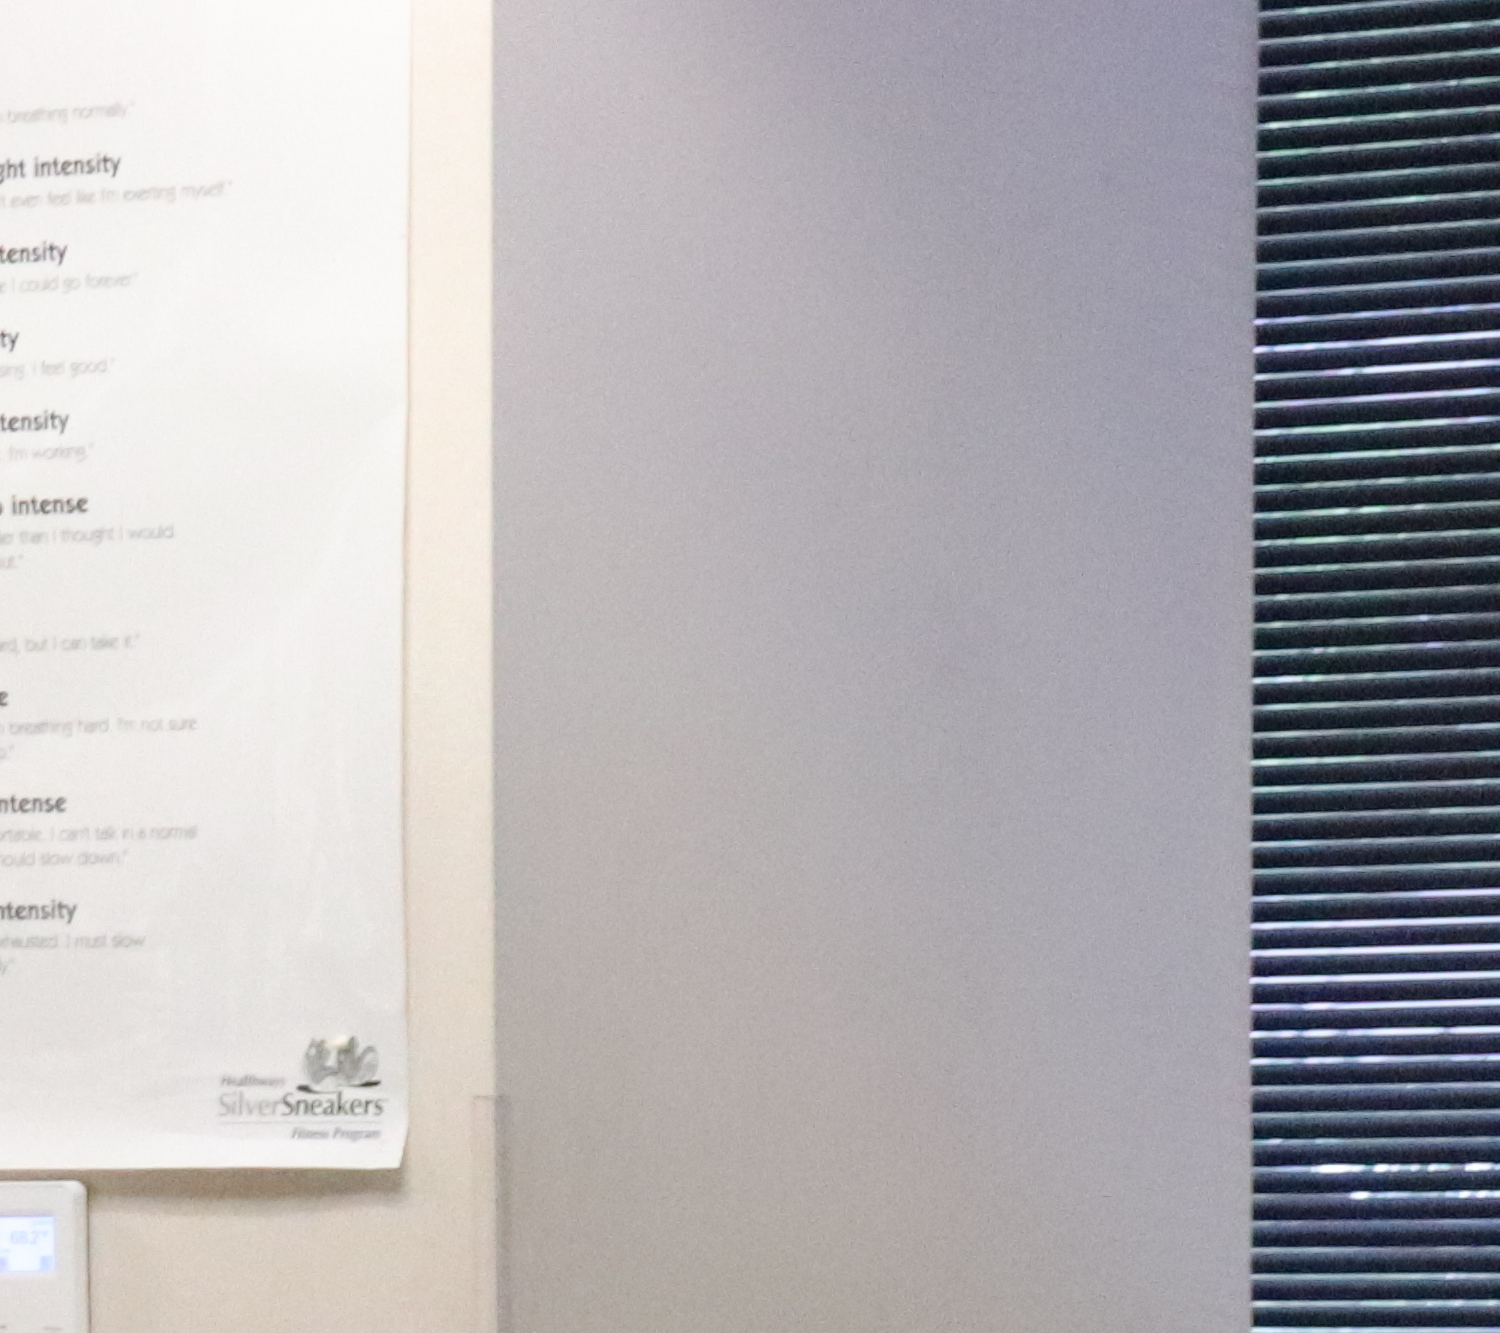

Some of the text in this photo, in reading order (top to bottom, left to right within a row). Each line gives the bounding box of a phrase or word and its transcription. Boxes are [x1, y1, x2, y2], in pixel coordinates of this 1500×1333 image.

[7, 107, 68, 124] breathing
[33, 152, 121, 178] intensity
[47, 190, 72, 207] feel
[19, 276, 59, 292] could
[63, 277, 81, 294] go
[41, 360, 65, 375] feel
[11, 495, 89, 515] intense
[60, 528, 114, 546] thought
[25, 638, 48, 652] but
[61, 637, 86, 651] can
[8, 720, 73, 737] breathing
[168, 718, 197, 731] sure
[40, 852, 73, 866] slow
[111, 934, 146, 949] slow
[219, 1091, 384, 1116] SilverSneakers
